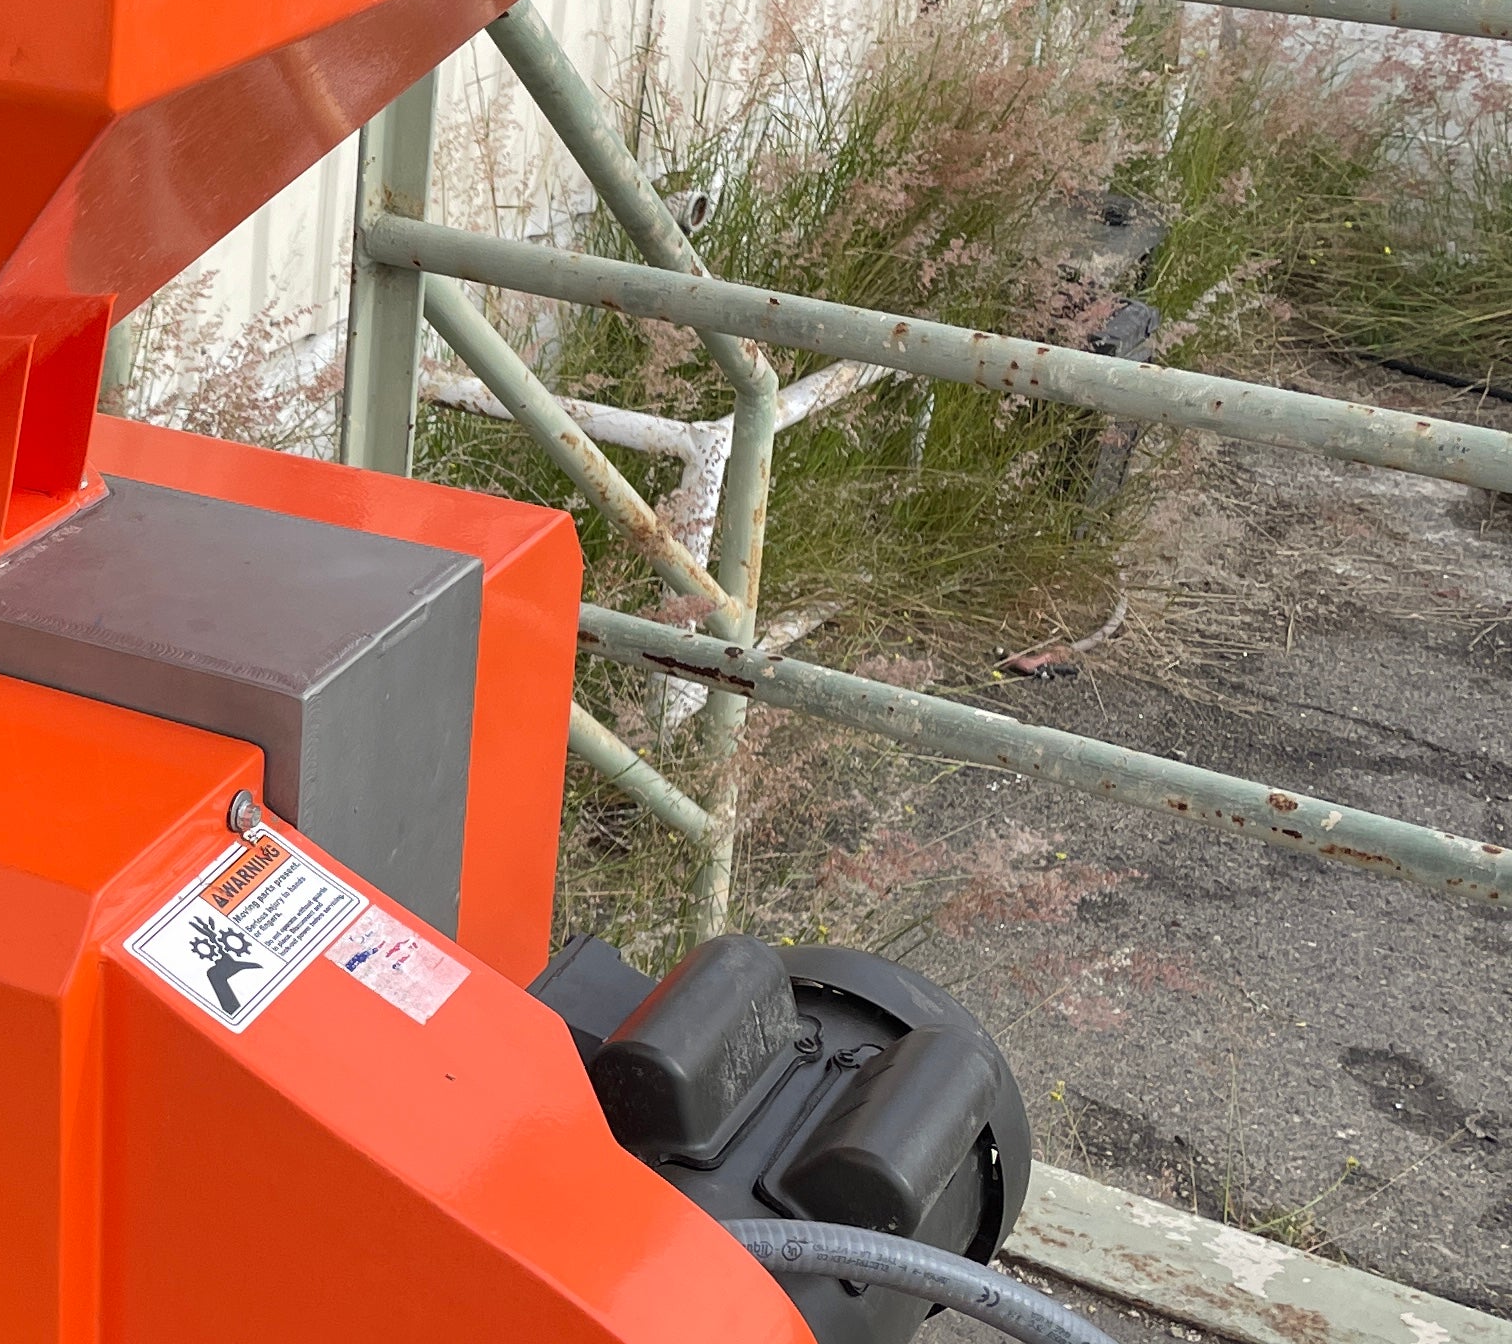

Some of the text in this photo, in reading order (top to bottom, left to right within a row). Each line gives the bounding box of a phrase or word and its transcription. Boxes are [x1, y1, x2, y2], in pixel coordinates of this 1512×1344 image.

[219, 844, 281, 898] WARNING
[232, 900, 260, 923] Moving
[257, 885, 275, 903] parts
